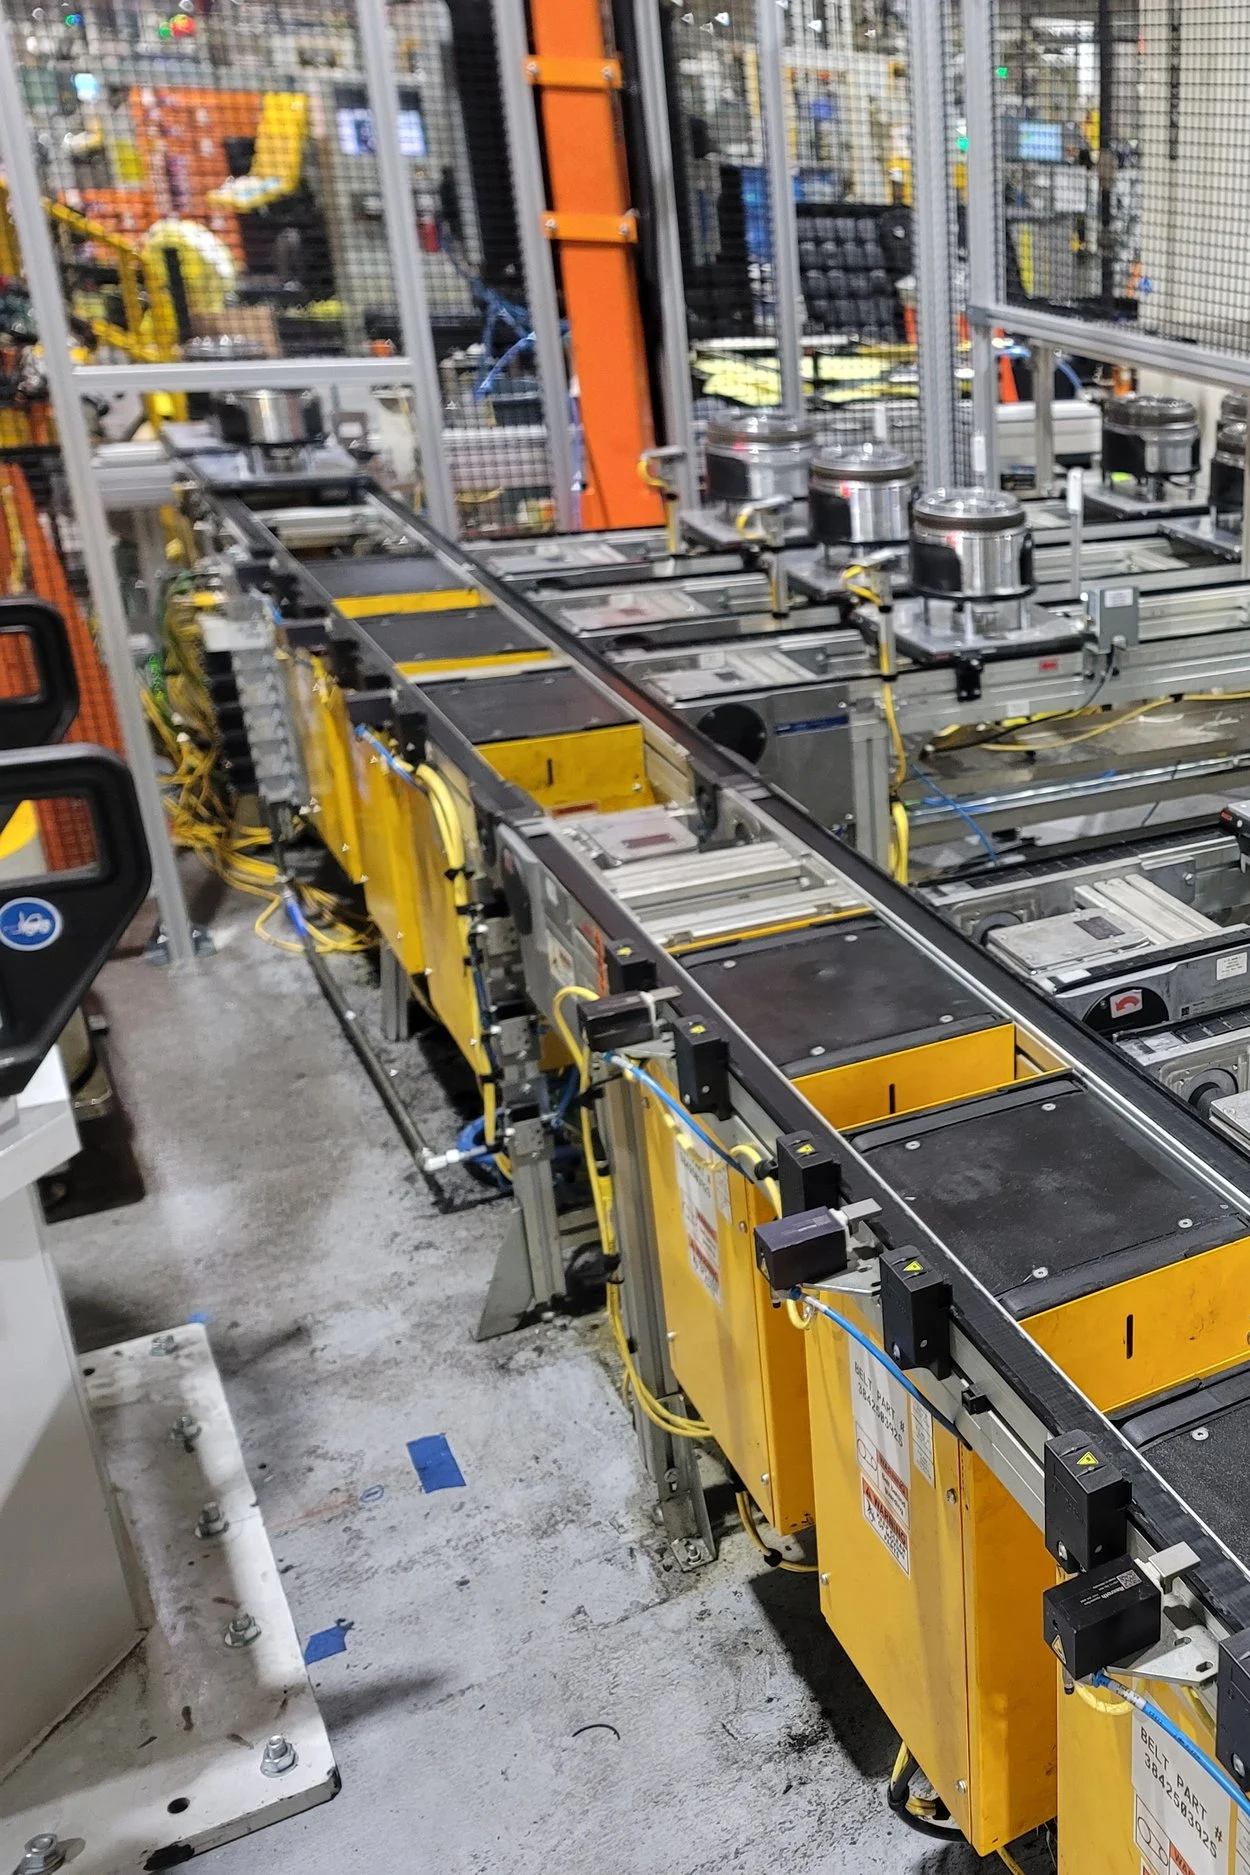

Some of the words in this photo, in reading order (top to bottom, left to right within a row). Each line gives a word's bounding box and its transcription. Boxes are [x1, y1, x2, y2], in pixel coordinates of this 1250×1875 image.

[1141, 1726, 1169, 1772] BELT
[1176, 1773, 1208, 1821] PART
[1215, 1825, 1223, 1842] #
